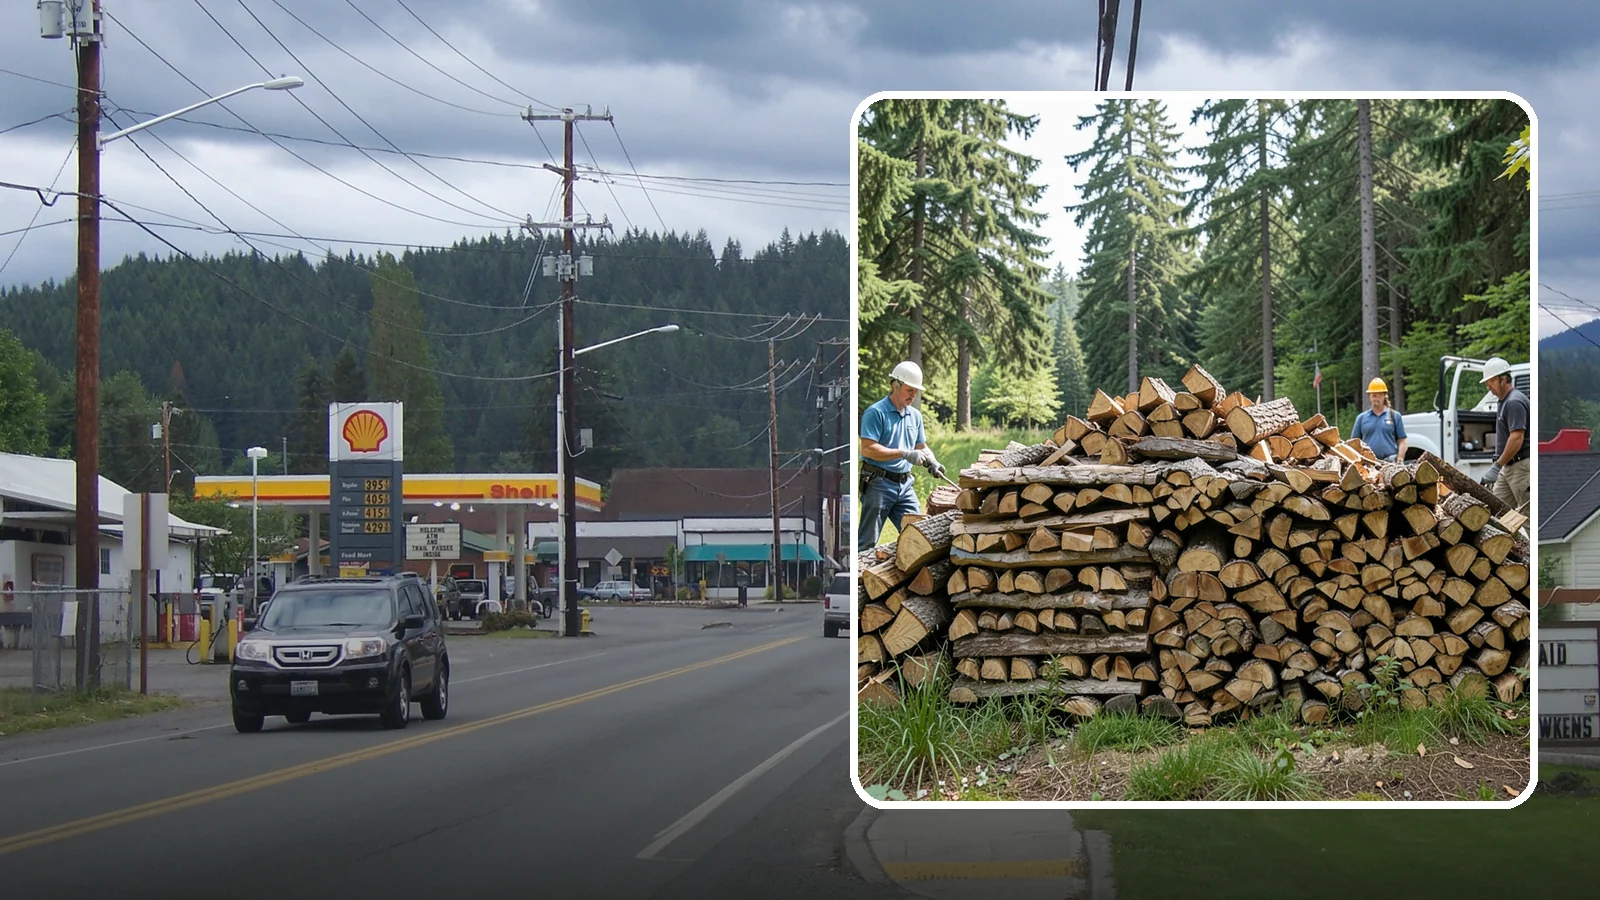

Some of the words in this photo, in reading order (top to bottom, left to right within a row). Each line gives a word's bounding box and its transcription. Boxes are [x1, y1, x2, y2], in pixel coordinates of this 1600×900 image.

[366, 480, 383, 490] 395
[490, 484, 547, 499] Shell
[366, 494, 383, 504] 405
[366, 508, 383, 518] 415
[366, 522, 383, 532] 429
[1538, 642, 1567, 665] AID
